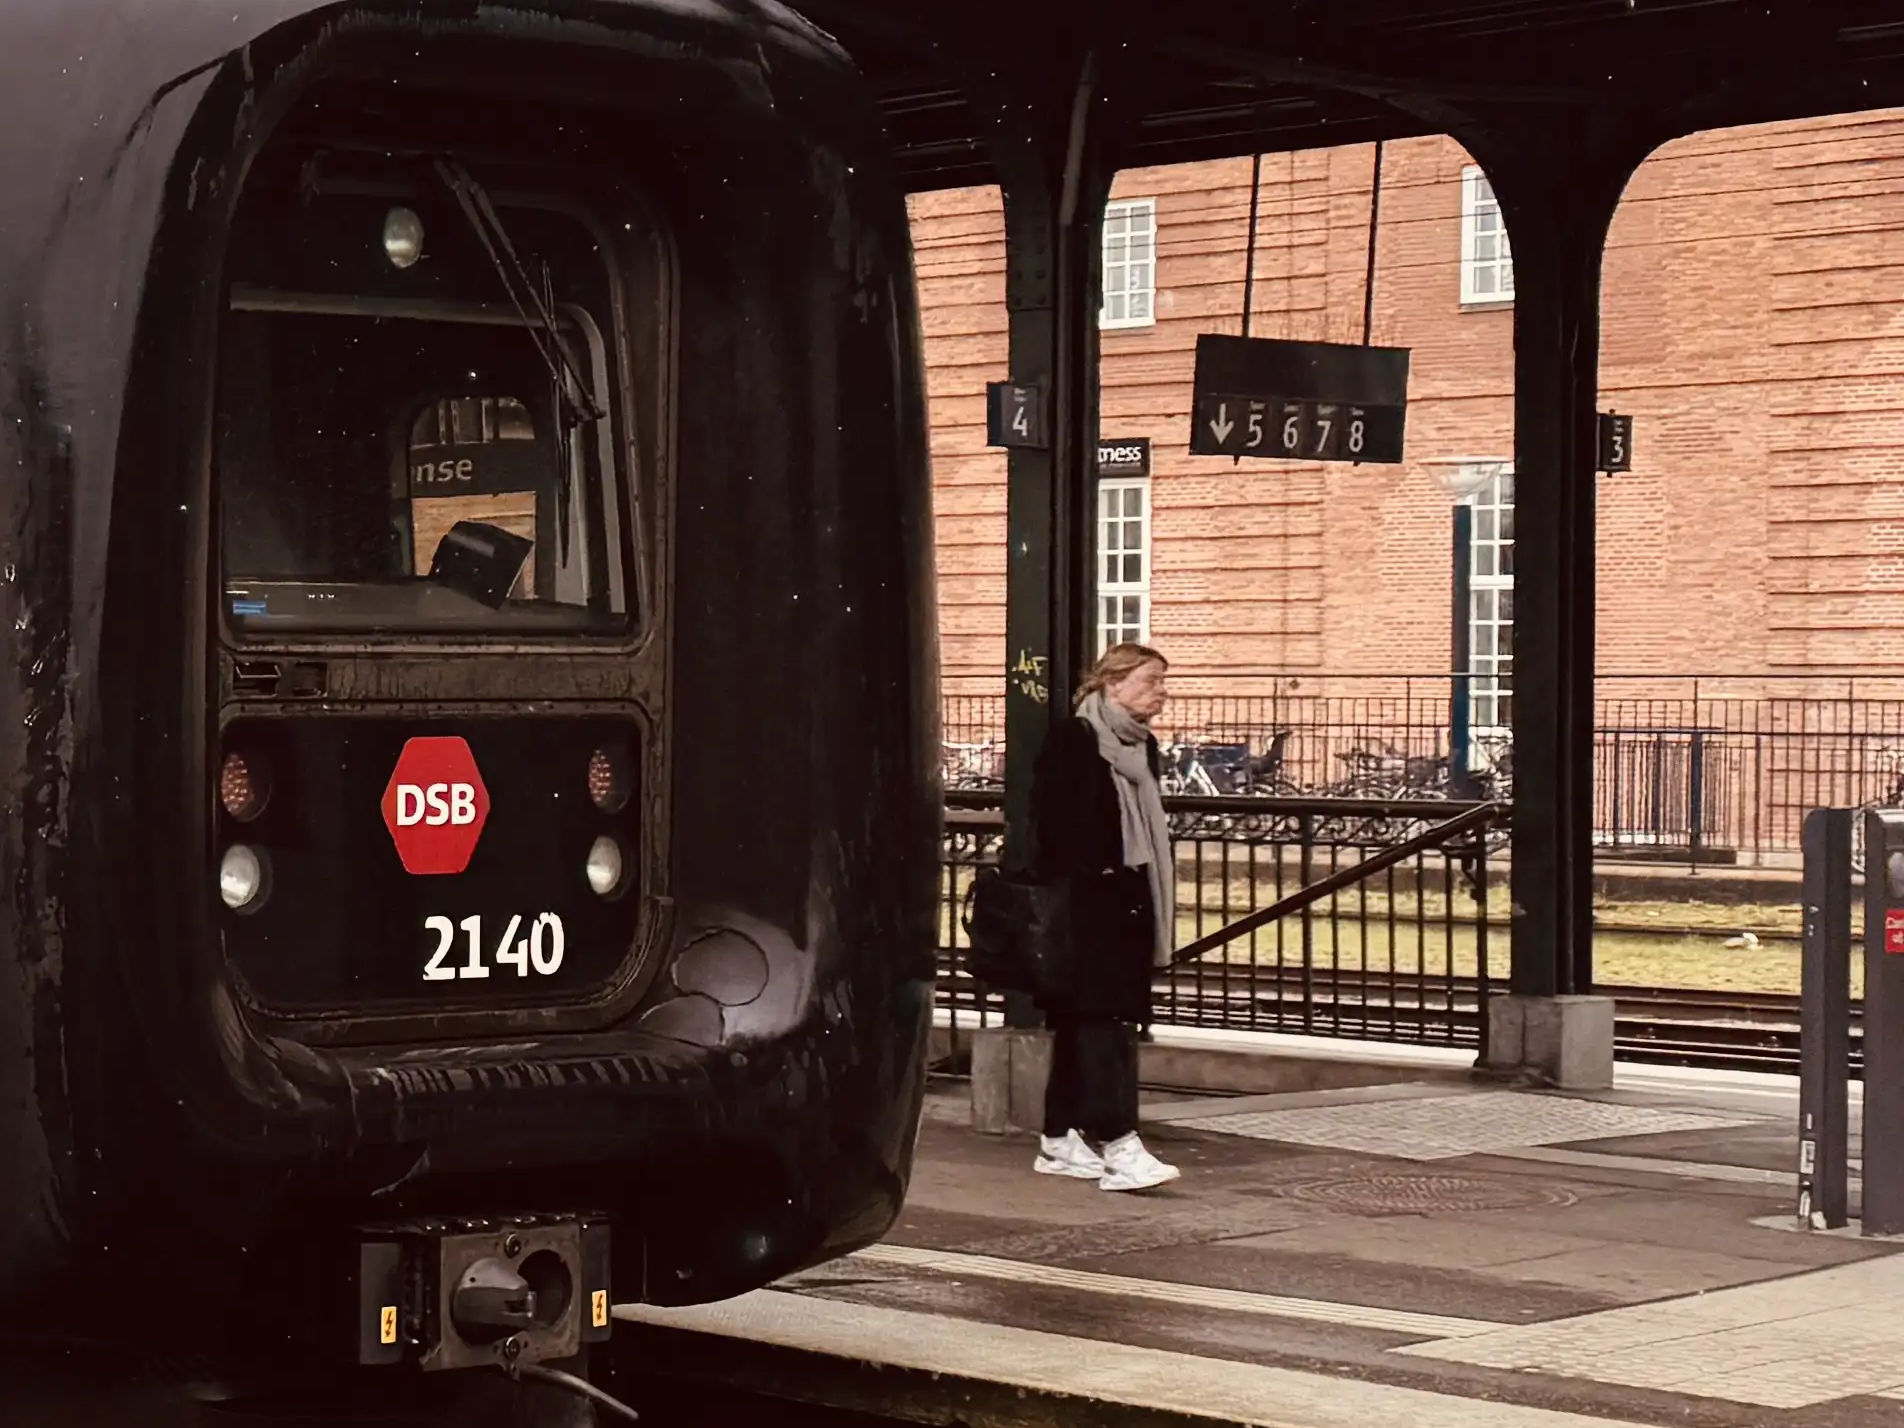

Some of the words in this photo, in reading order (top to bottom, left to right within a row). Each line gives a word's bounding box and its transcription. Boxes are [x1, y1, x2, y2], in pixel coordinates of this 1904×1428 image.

[1012, 406, 1028, 436] 4
[1246, 414, 1263, 447] 5
[1283, 416, 1299, 449] 6
[1317, 420, 1332, 452] 7
[1349, 420, 1364, 453] 8
[1611, 435, 1624, 463] 3
[411, 457, 474, 483] nse
[396, 782, 476, 826] DSB
[422, 911, 565, 981] 2140
